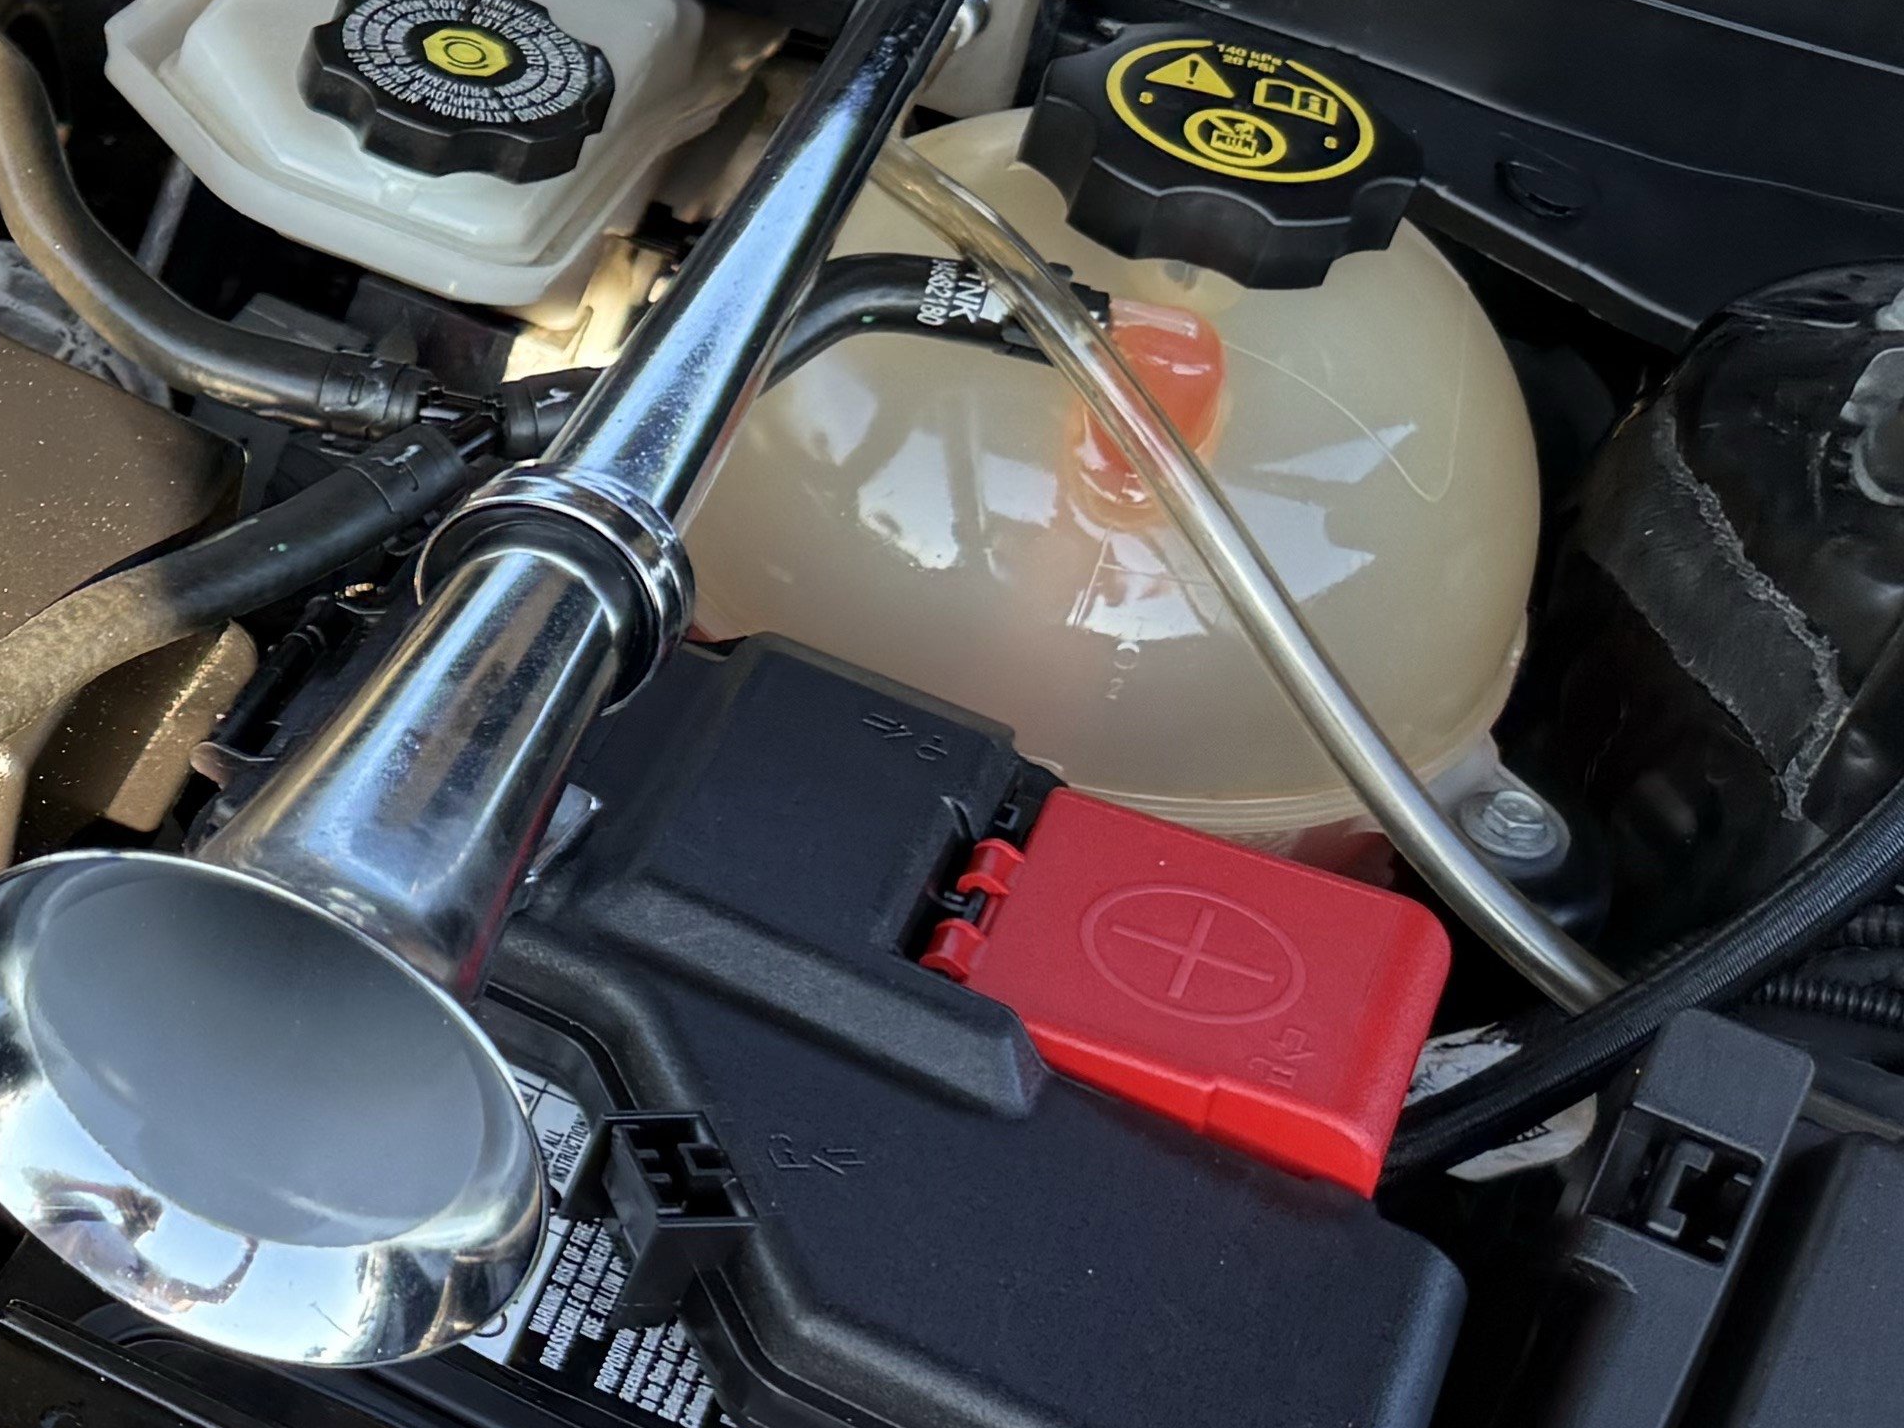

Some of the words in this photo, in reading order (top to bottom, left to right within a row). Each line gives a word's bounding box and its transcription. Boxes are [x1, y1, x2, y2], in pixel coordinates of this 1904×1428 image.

[1216, 43, 1247, 59] 140
[1247, 58, 1276, 74] PSI
[543, 1129, 565, 1151] ALL
[562, 1243, 585, 1263] OF
[551, 1258, 579, 1287] RISK
[590, 1271, 625, 1316] FOLLOW
[527, 1283, 572, 1335] WARNING:
[539, 1297, 596, 1371] DISASSEMBLE
[570, 1282, 594, 1302] OR
[593, 1327, 645, 1394] PROPOSITION
